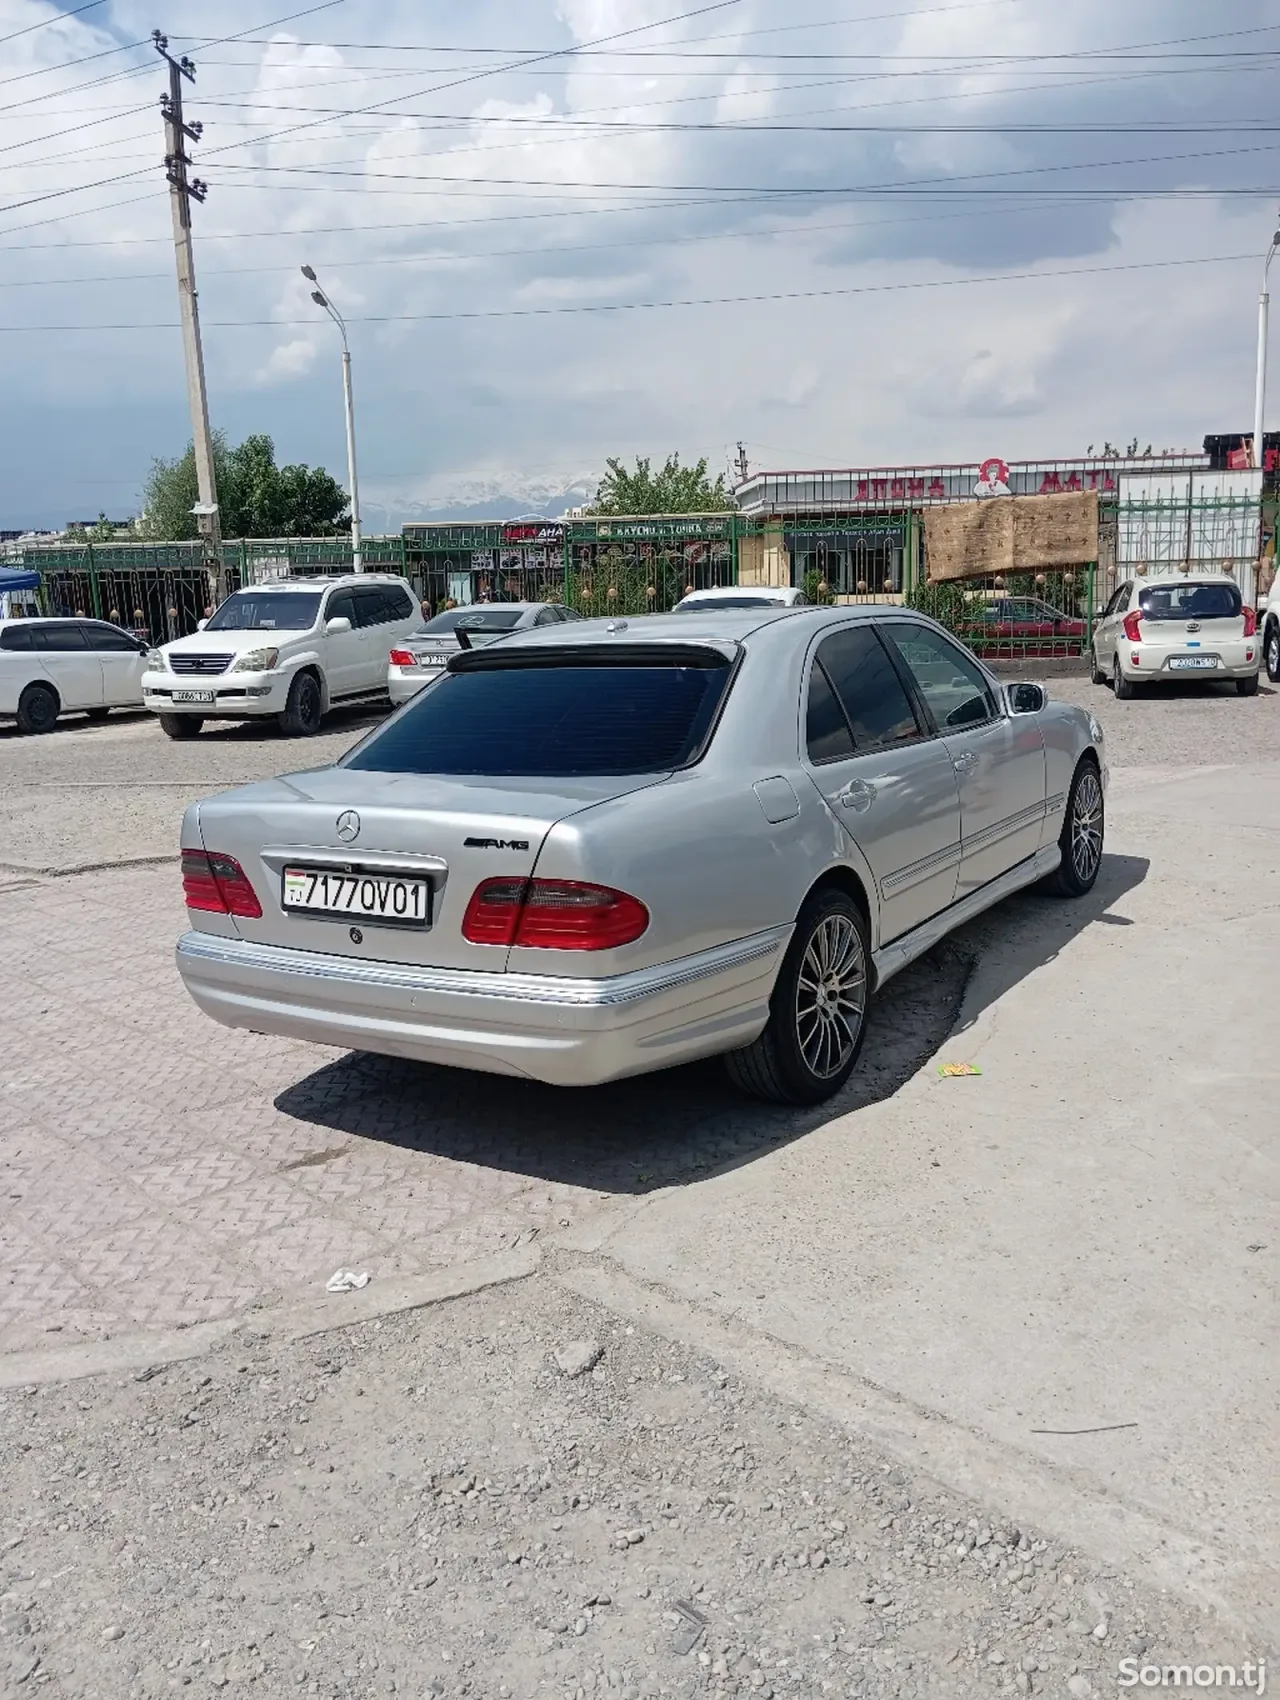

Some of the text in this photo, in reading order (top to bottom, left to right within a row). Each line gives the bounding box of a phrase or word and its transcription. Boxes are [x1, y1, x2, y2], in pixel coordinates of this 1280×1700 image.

[1040, 469, 1115, 493] МАТЬ
[483, 838, 529, 851] AMG
[305, 873, 419, 917] 7177QV01
